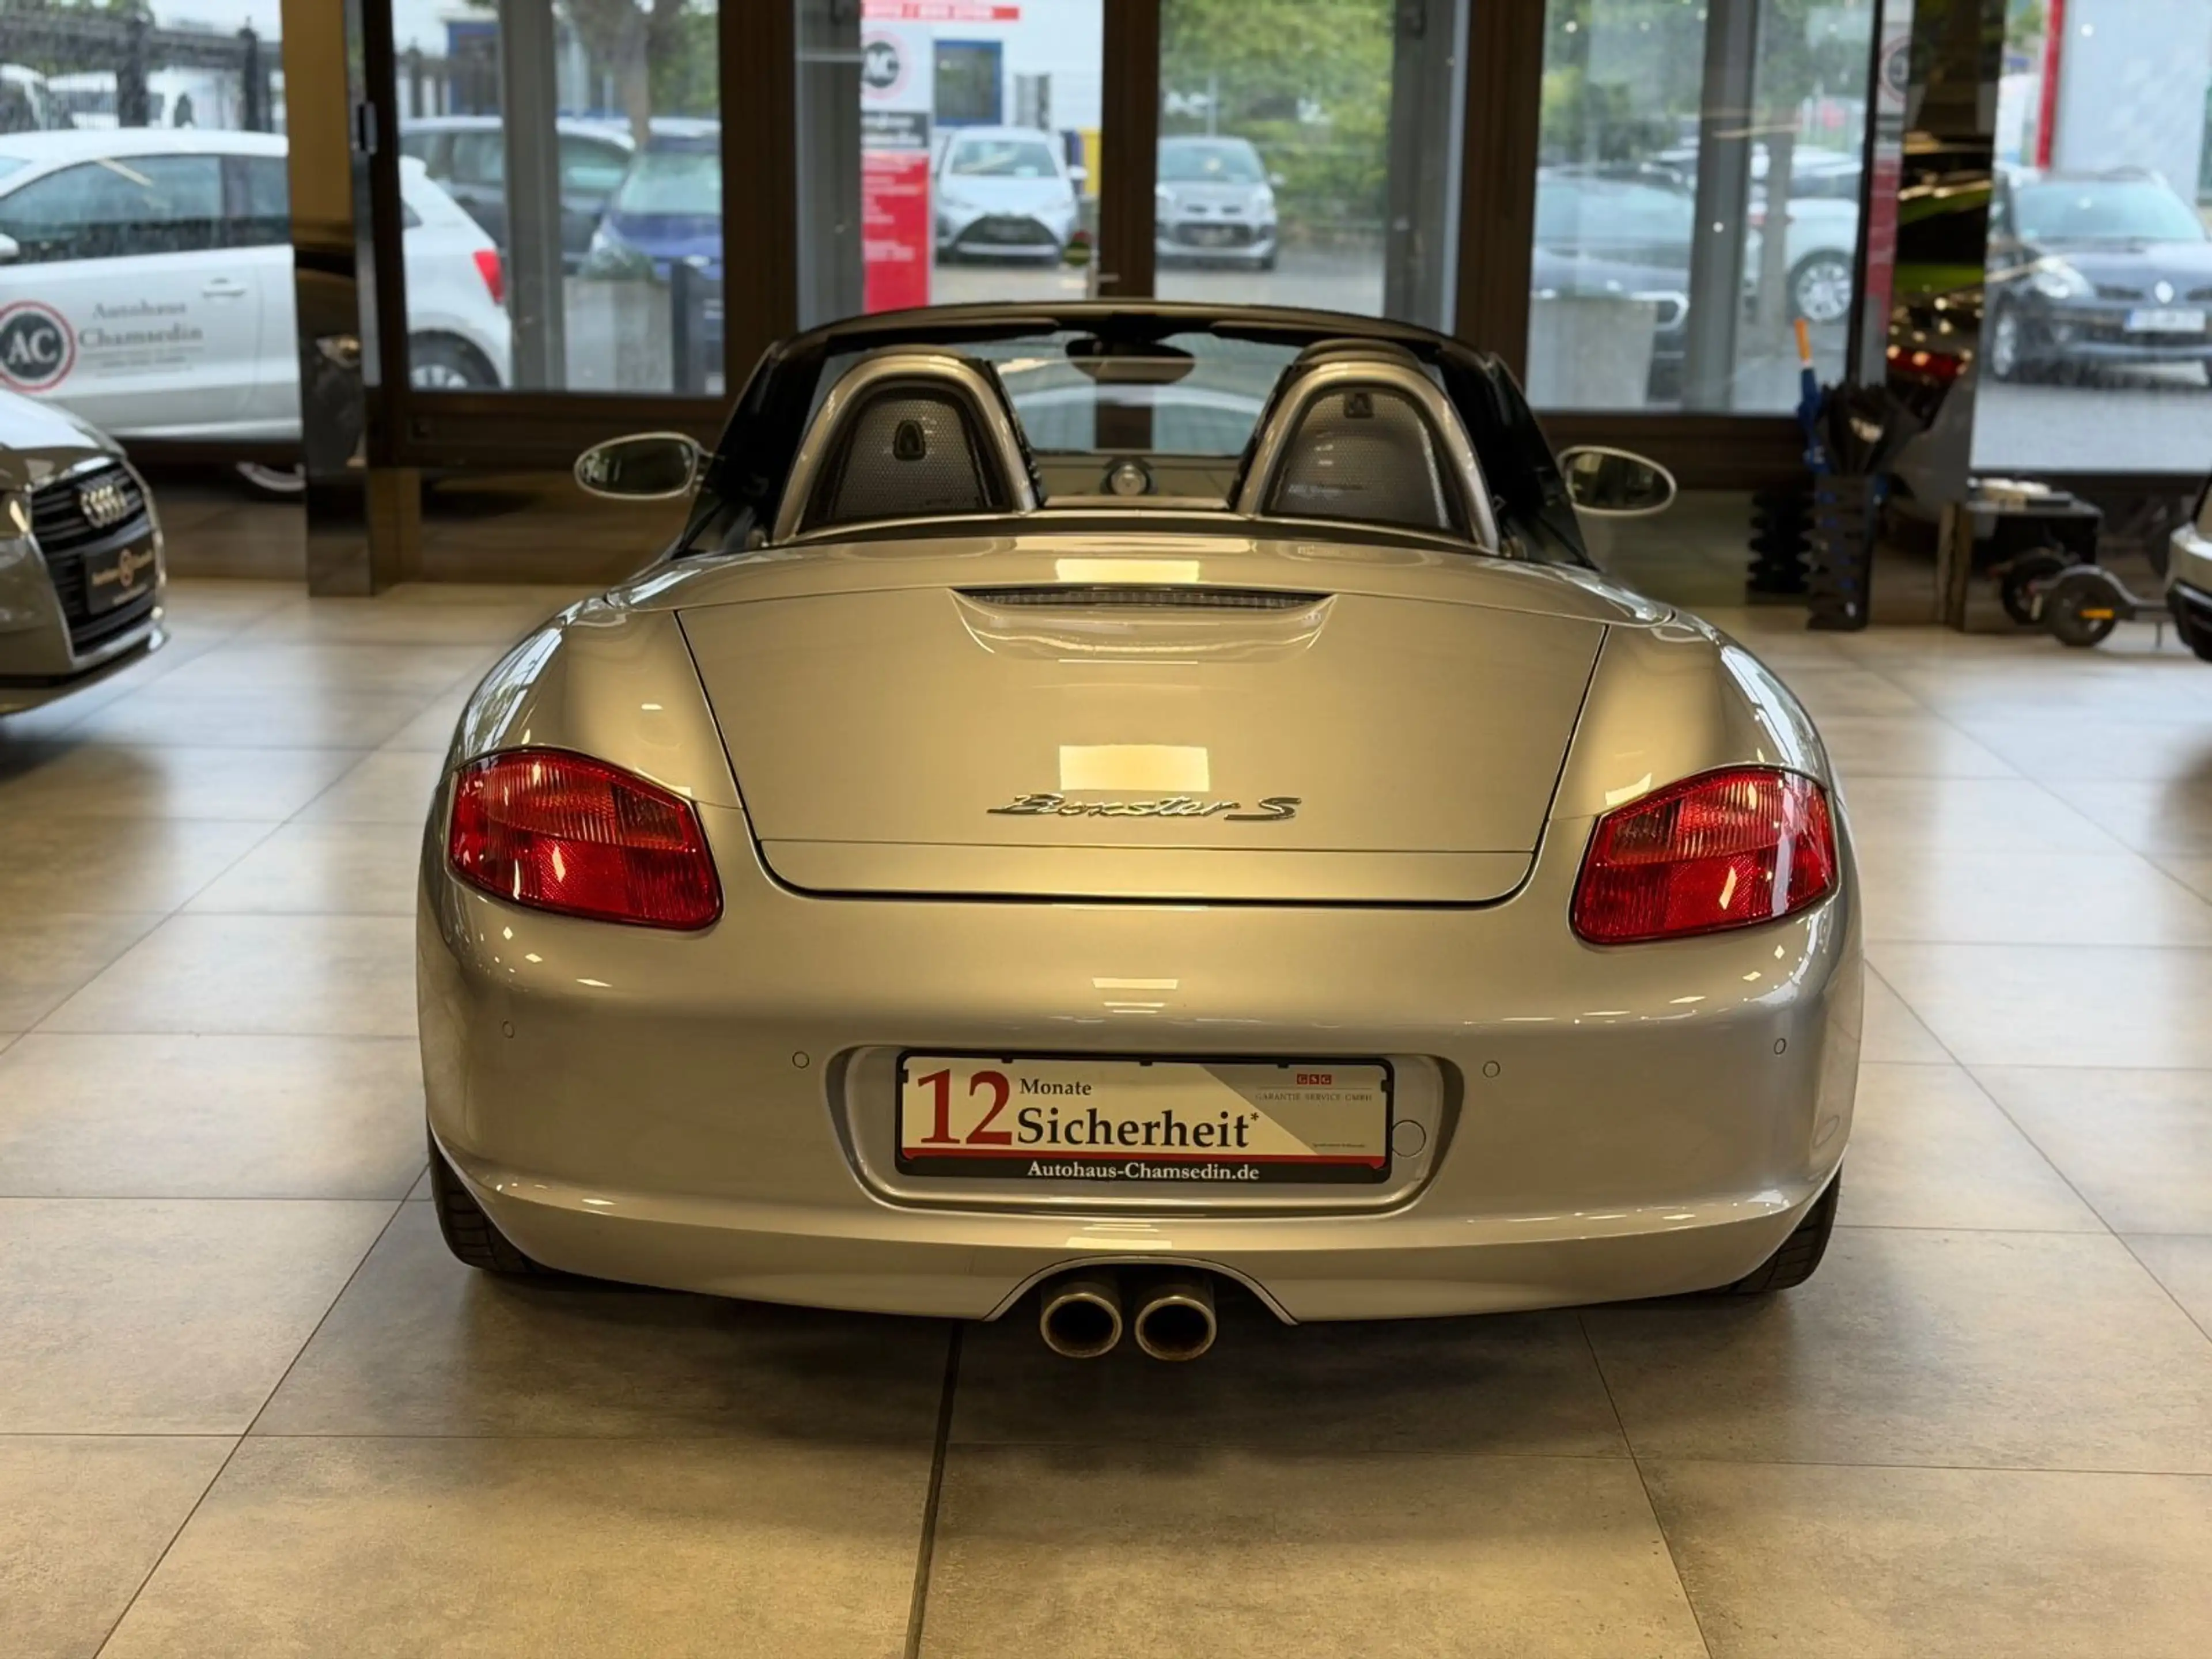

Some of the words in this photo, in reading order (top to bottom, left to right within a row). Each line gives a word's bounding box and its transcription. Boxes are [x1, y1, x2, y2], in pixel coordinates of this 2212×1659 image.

[8, 327, 56, 364] AC
[987, 793, 1240, 816] Boxster
[1224, 797, 1301, 820] S
[1020, 1078, 1092, 1096] Monate
[918, 1068, 1012, 1145] 12
[1027, 1161, 1260, 1180] Autohaus-Chamsedin.de
